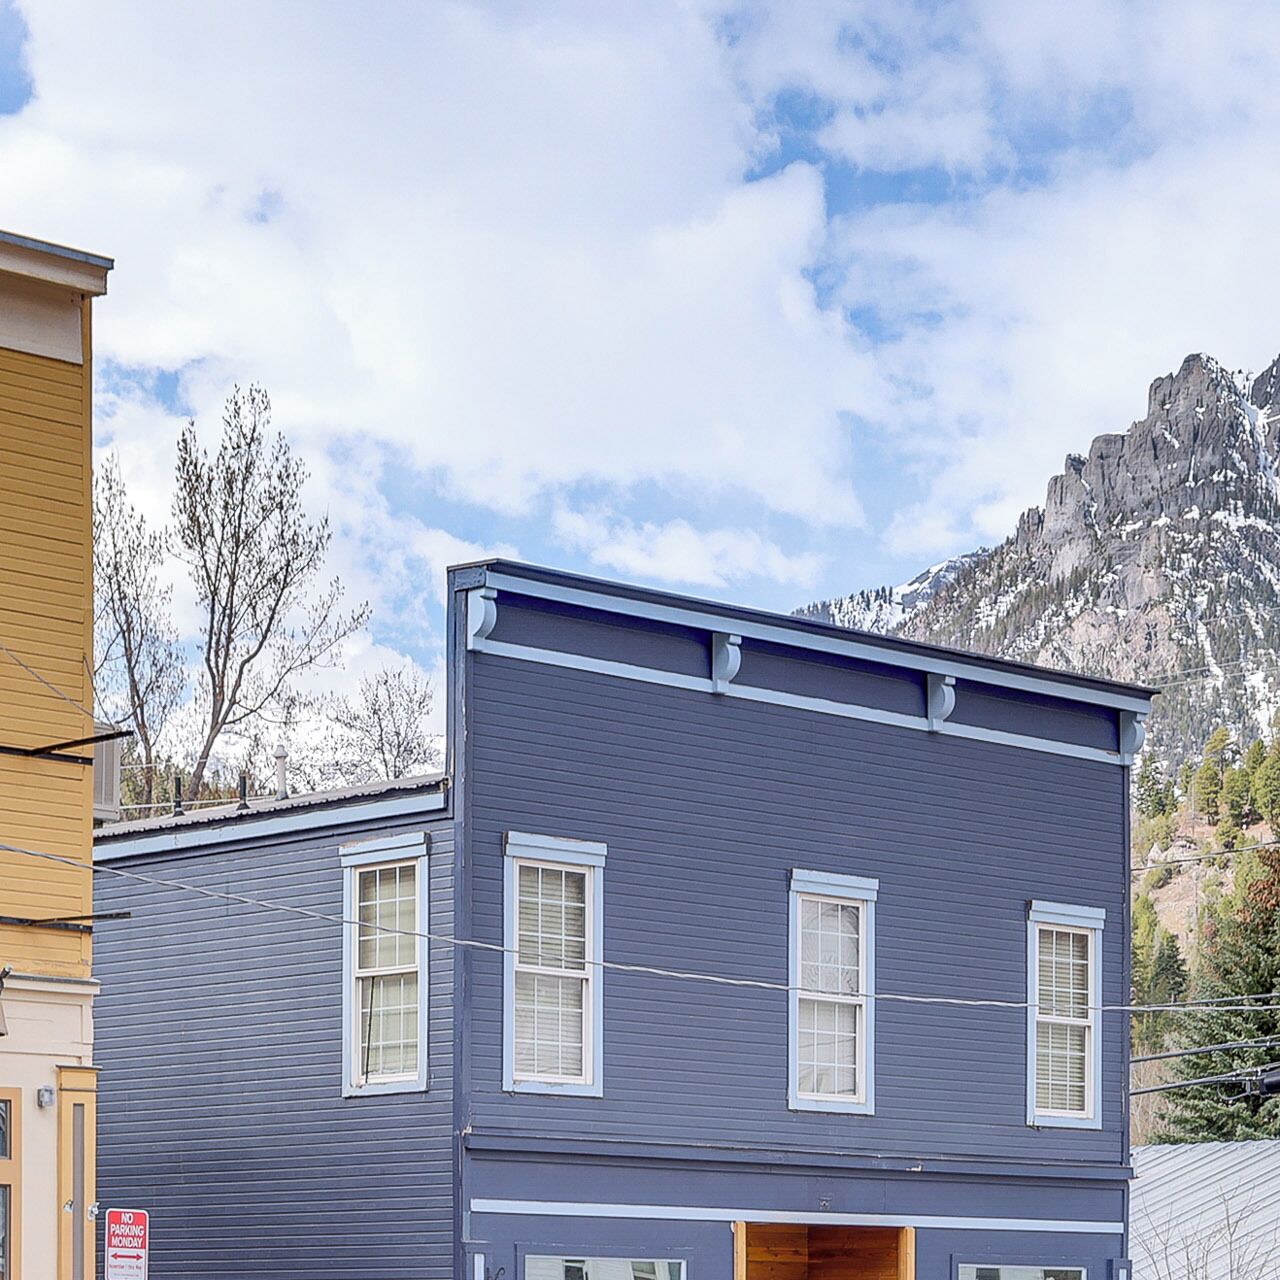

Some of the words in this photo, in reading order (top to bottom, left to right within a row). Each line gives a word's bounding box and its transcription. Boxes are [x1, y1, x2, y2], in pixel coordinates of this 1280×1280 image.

[121, 1212, 134, 1224] NO
[110, 1224, 144, 1236] PARKING
[111, 1236, 143, 1248] MONDAY
